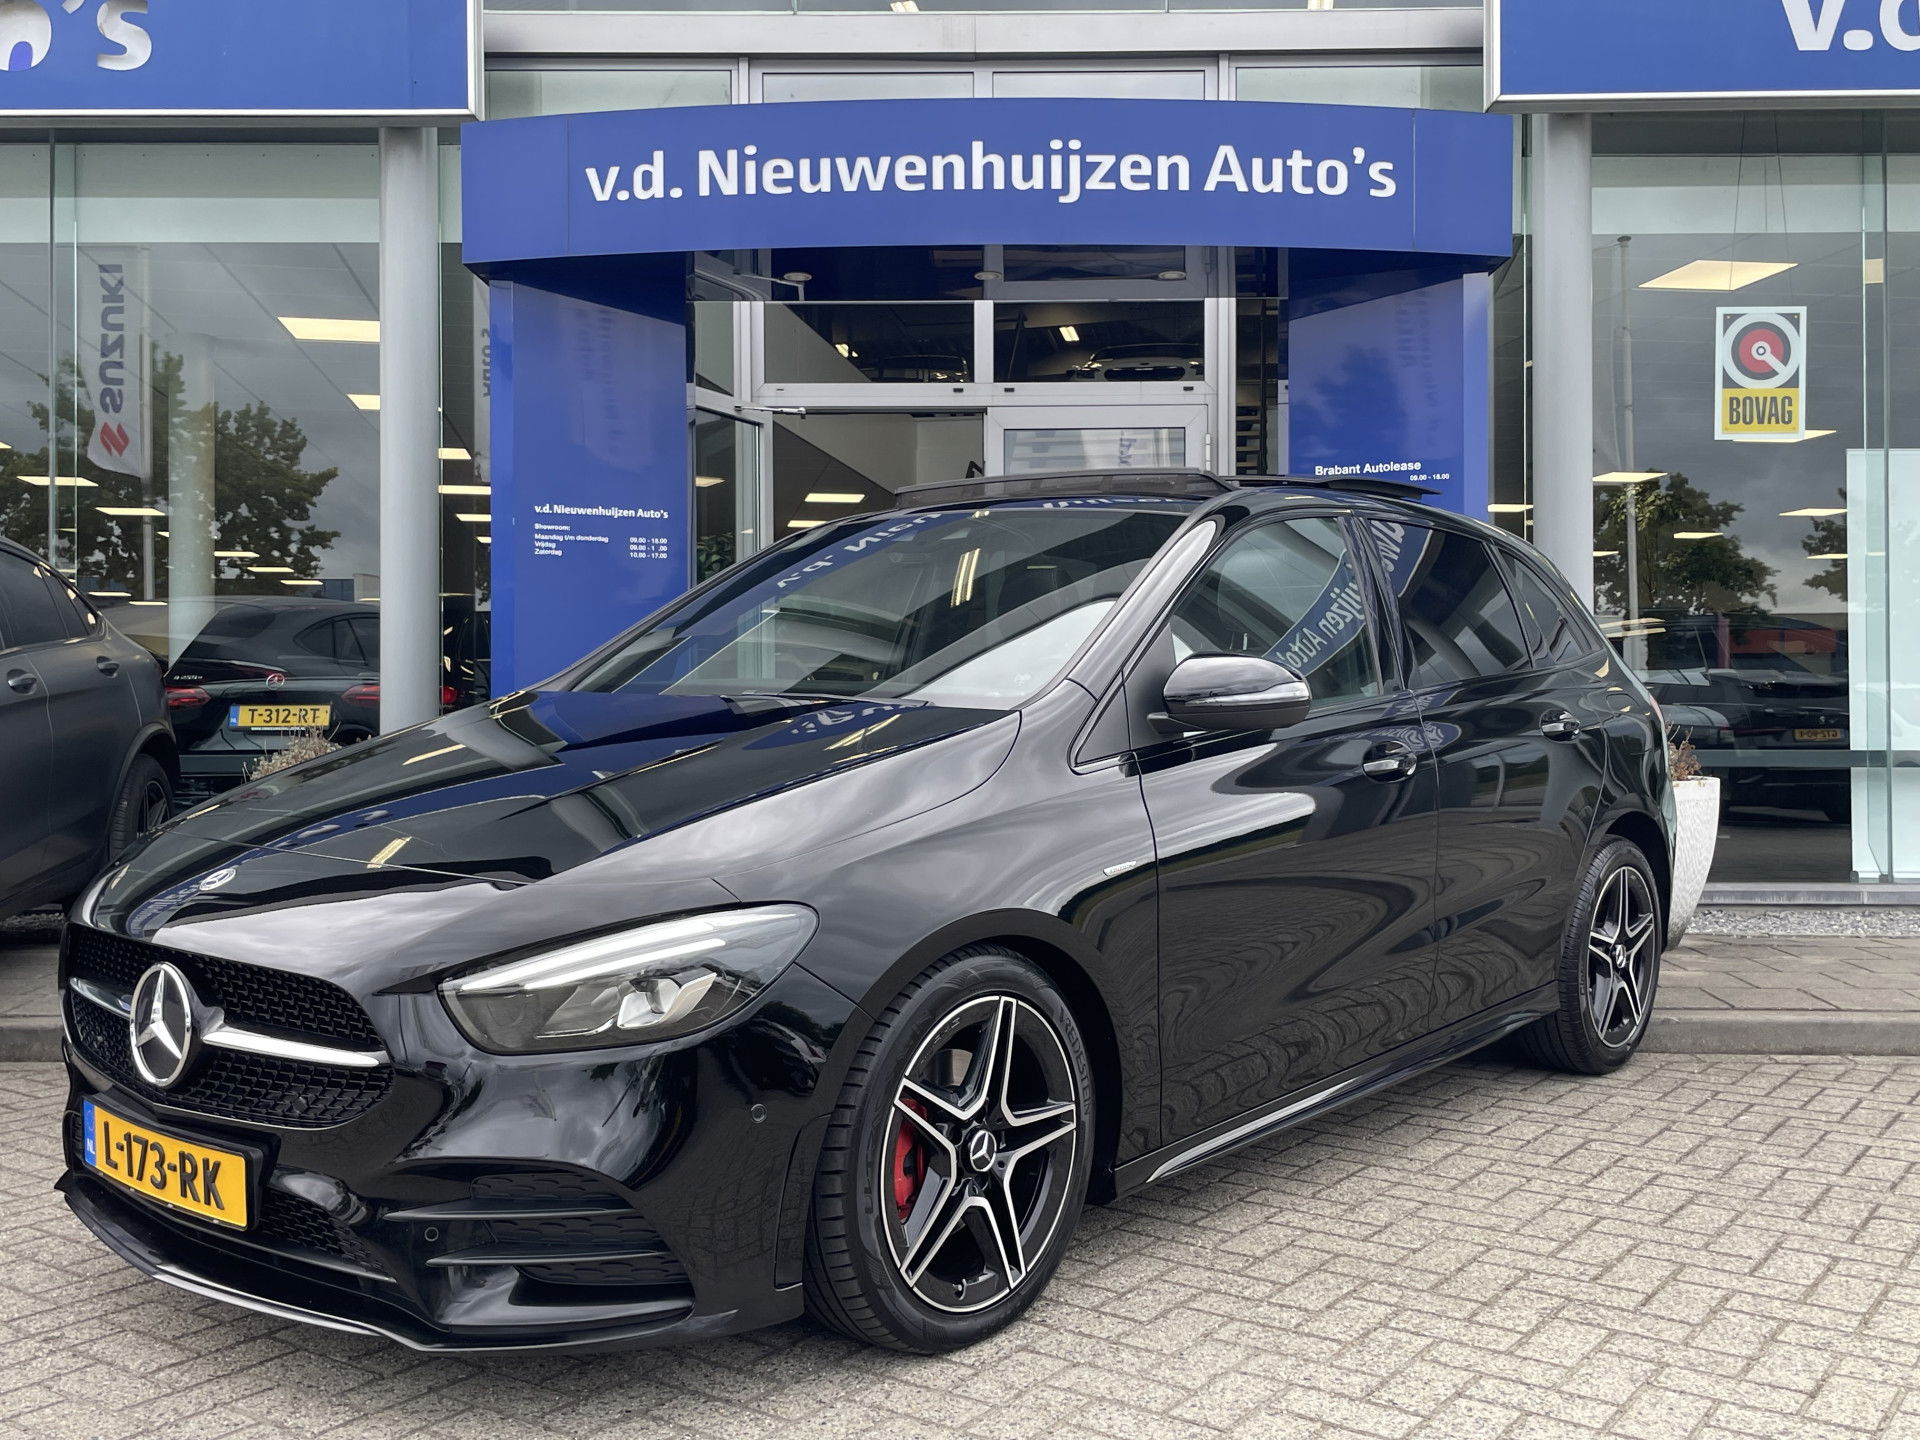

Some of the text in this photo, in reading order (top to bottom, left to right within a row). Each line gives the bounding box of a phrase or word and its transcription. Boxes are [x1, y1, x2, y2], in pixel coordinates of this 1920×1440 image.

[585, 139, 1397, 203] v.d. Nieuwenhuijzen Auto's
[1729, 396, 1793, 425] BOVAG
[1315, 461, 1421, 475] Brabant Autolease
[534, 504, 669, 519] v.d. Nieuwenhuijzen Auto's
[534, 523, 571, 531] Showroom:
[534, 533, 563, 541] Maandag
[576, 535, 609, 543] donderdag
[534, 541, 556, 549] Vrijdag
[534, 548, 562, 556] Zaterdag
[248, 708, 320, 724] T-312-RT
[1058, 1006, 1092, 1116] VREDESTEIN
[86, 1120, 225, 1211] NL L-173-RK
